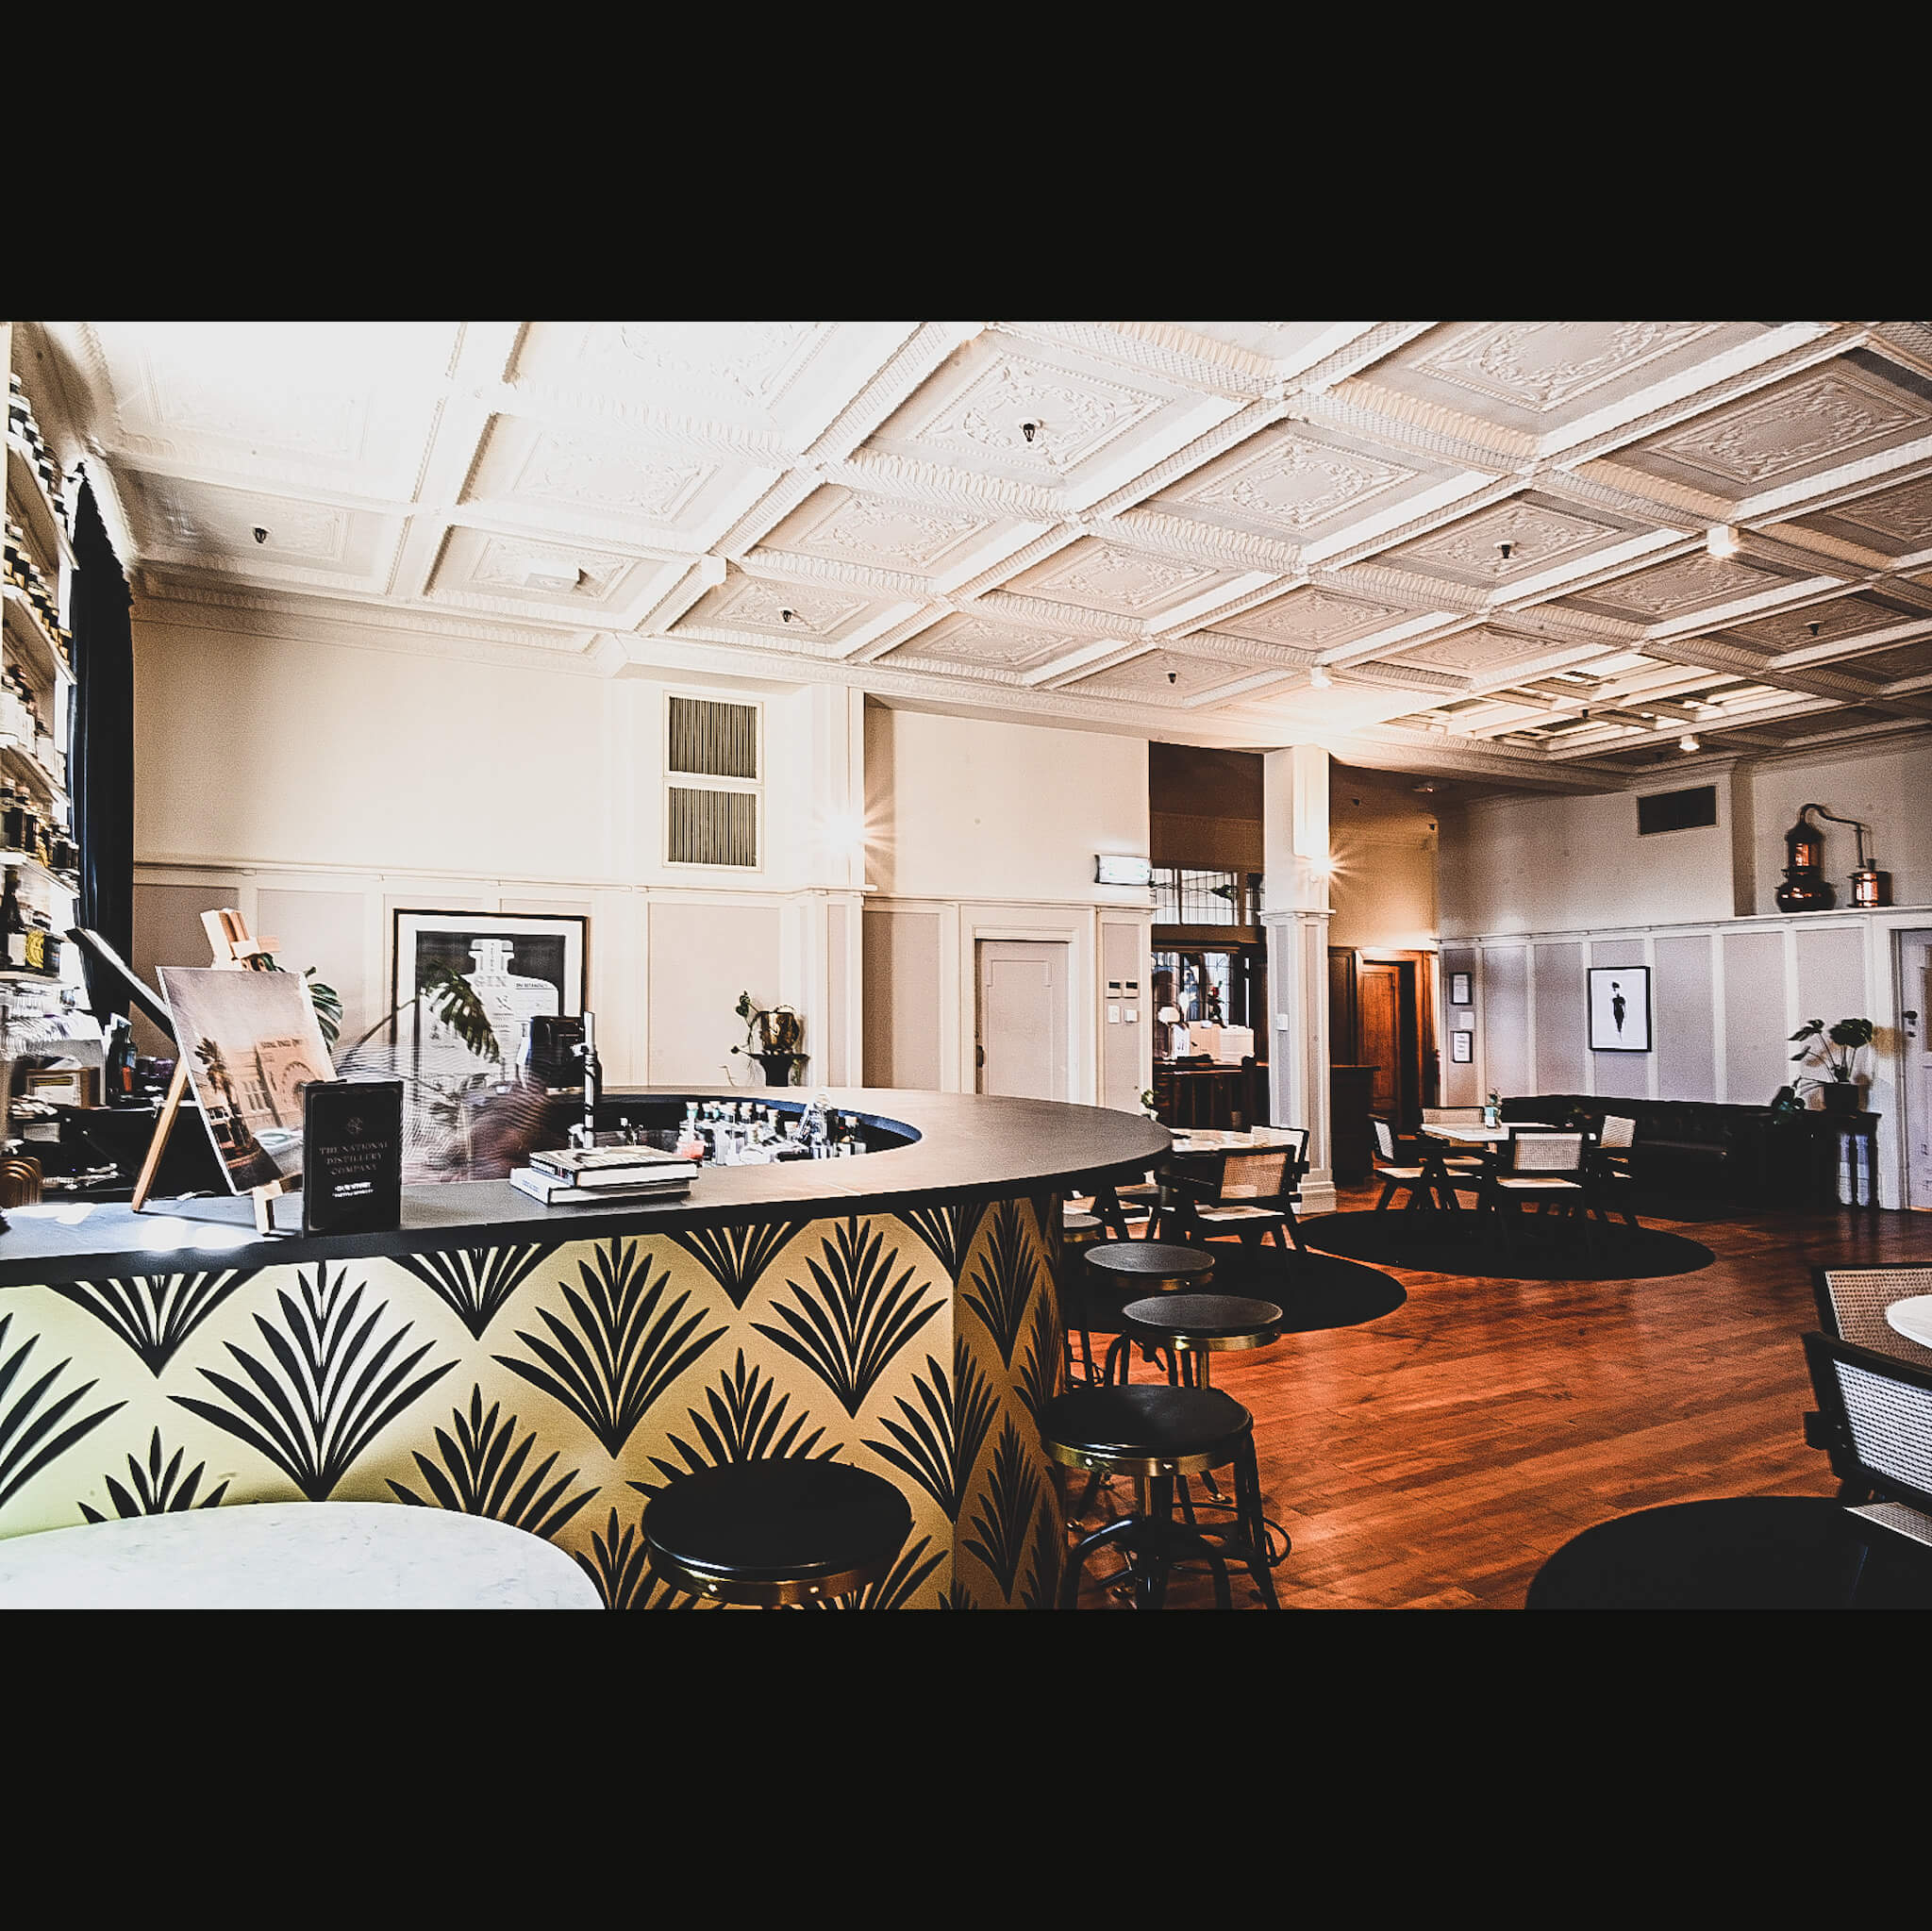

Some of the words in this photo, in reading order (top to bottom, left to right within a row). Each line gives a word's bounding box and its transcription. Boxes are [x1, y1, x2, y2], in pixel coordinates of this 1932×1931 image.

[318, 1146, 338, 1156] THE
[341, 1140, 389, 1153] NATIONAL
[326, 1152, 382, 1165] DISTILLERY
[330, 1164, 377, 1175] COMPANY
